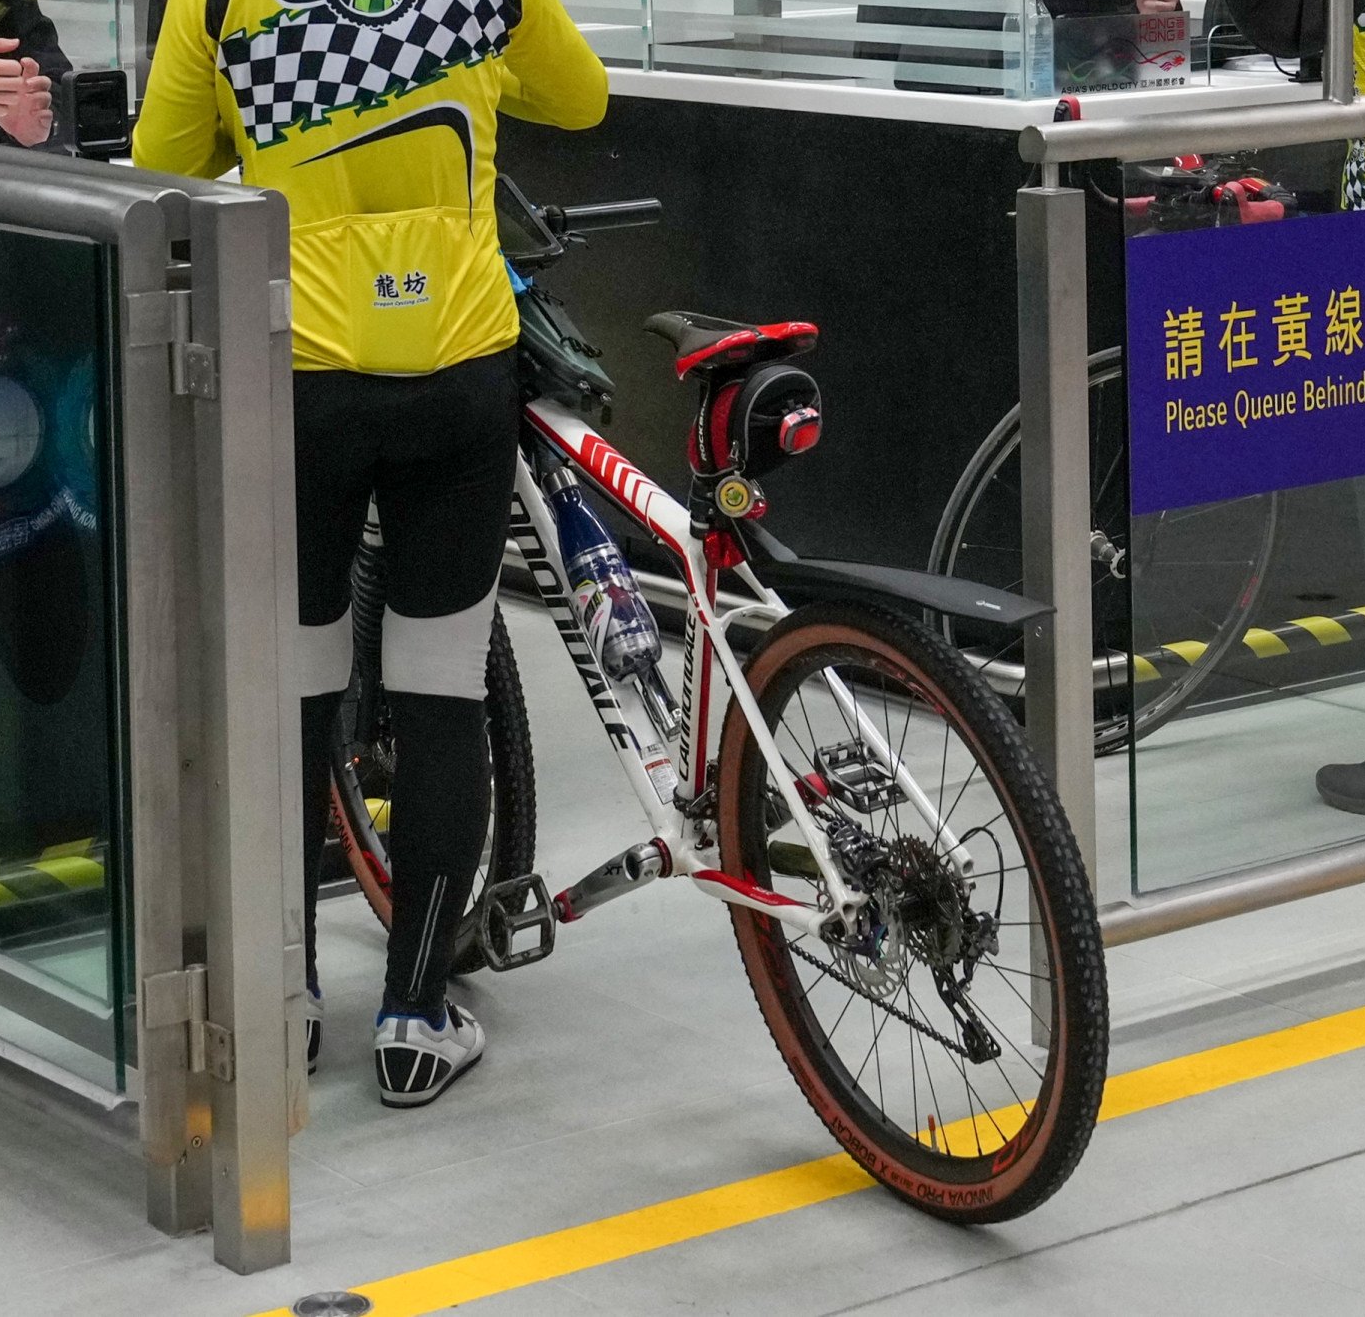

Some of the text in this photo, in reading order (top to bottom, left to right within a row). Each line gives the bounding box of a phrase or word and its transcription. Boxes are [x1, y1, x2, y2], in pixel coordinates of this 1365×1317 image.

[1138, 17, 1175, 30] HONG
[1138, 29, 1175, 43] KONG
[1061, 81, 1139, 95] ASIA'S WORLD CITY
[374, 271, 427, 298] 龍坊
[1166, 400, 1228, 434] Please
[1235, 389, 1297, 429] Queue
[602, 865, 623, 877] XT
[830, 1115, 877, 1167] BOBCAT
[916, 1182, 994, 1207] INNOVA PRO
